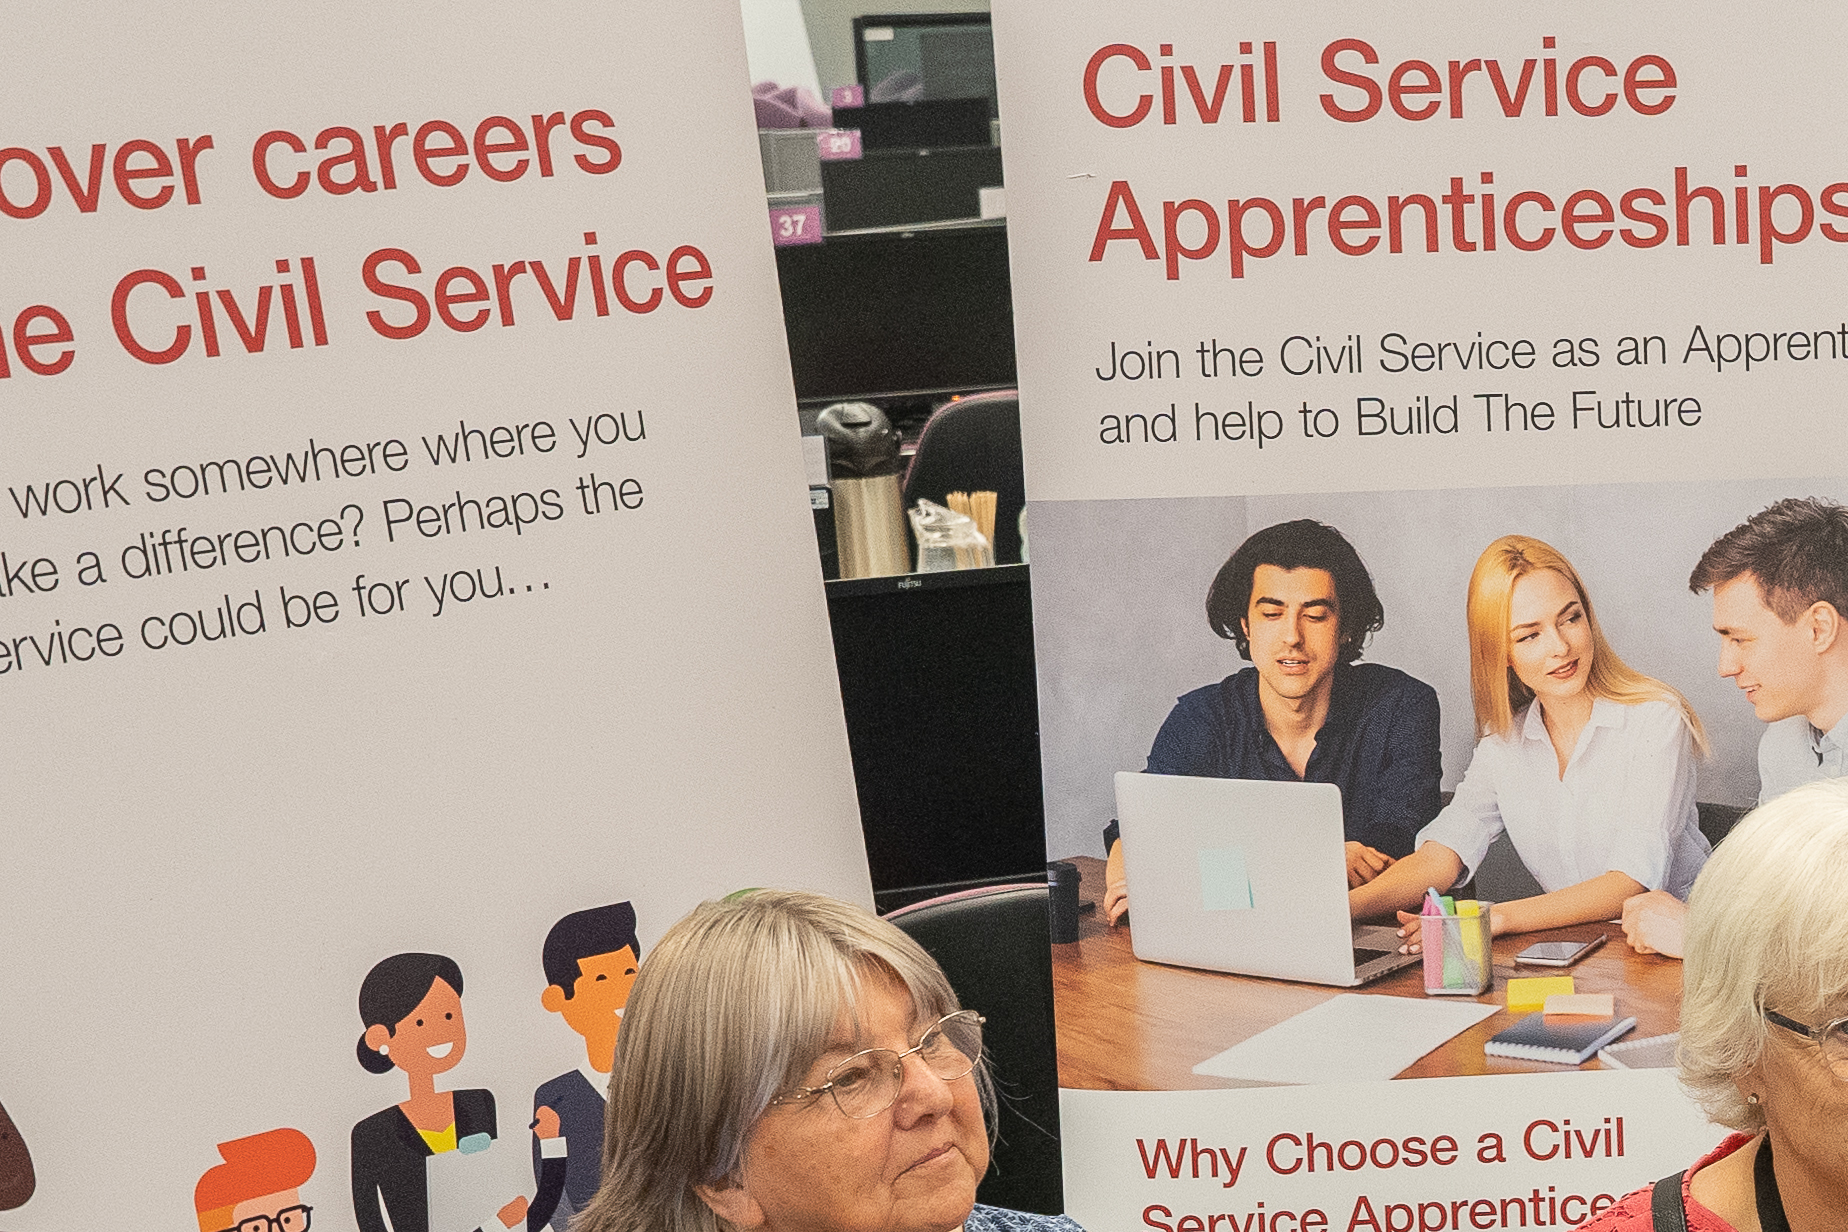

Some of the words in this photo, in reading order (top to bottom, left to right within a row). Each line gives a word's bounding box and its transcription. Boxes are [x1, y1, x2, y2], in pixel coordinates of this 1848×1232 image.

[1083, 41, 1281, 128] Civil
[1319, 36, 1678, 124] Service
[251, 105, 625, 200] careers
[778, 214, 806, 237] 37
[0, 305, 76, 379] e
[109, 257, 329, 366] Civil
[361, 232, 715, 341] Service
[1096, 339, 1182, 382] Join
[1196, 337, 1264, 379] the
[1279, 334, 1363, 378] Civil
[1378, 328, 1537, 375] Service
[1550, 333, 1600, 371] as
[1616, 330, 1668, 368] an
[1099, 402, 1178, 446] and
[1193, 400, 1284, 451] help
[1298, 401, 1340, 439] to
[1355, 394, 1460, 438] Build
[1473, 391, 1556, 434] The
[1570, 390, 1703, 431] Future
[8, 464, 130, 519] work
[144, 435, 410, 503] somewhere
[421, 413, 558, 468] where
[568, 409, 647, 459] you
[0, 551, 59, 598] ke
[76, 551, 107, 585] a
[121, 504, 366, 580] difference?
[383, 486, 564, 543] Perhaps
[575, 469, 644, 517] the
[141, 595, 266, 652] could
[284, 585, 340, 633] be
[352, 575, 410, 617] for
[1136, 1132, 1248, 1189] Why
[1266, 1130, 1458, 1176] Choose
[1476, 1131, 1506, 1163] a
[1523, 1116, 1626, 1162] Civil
